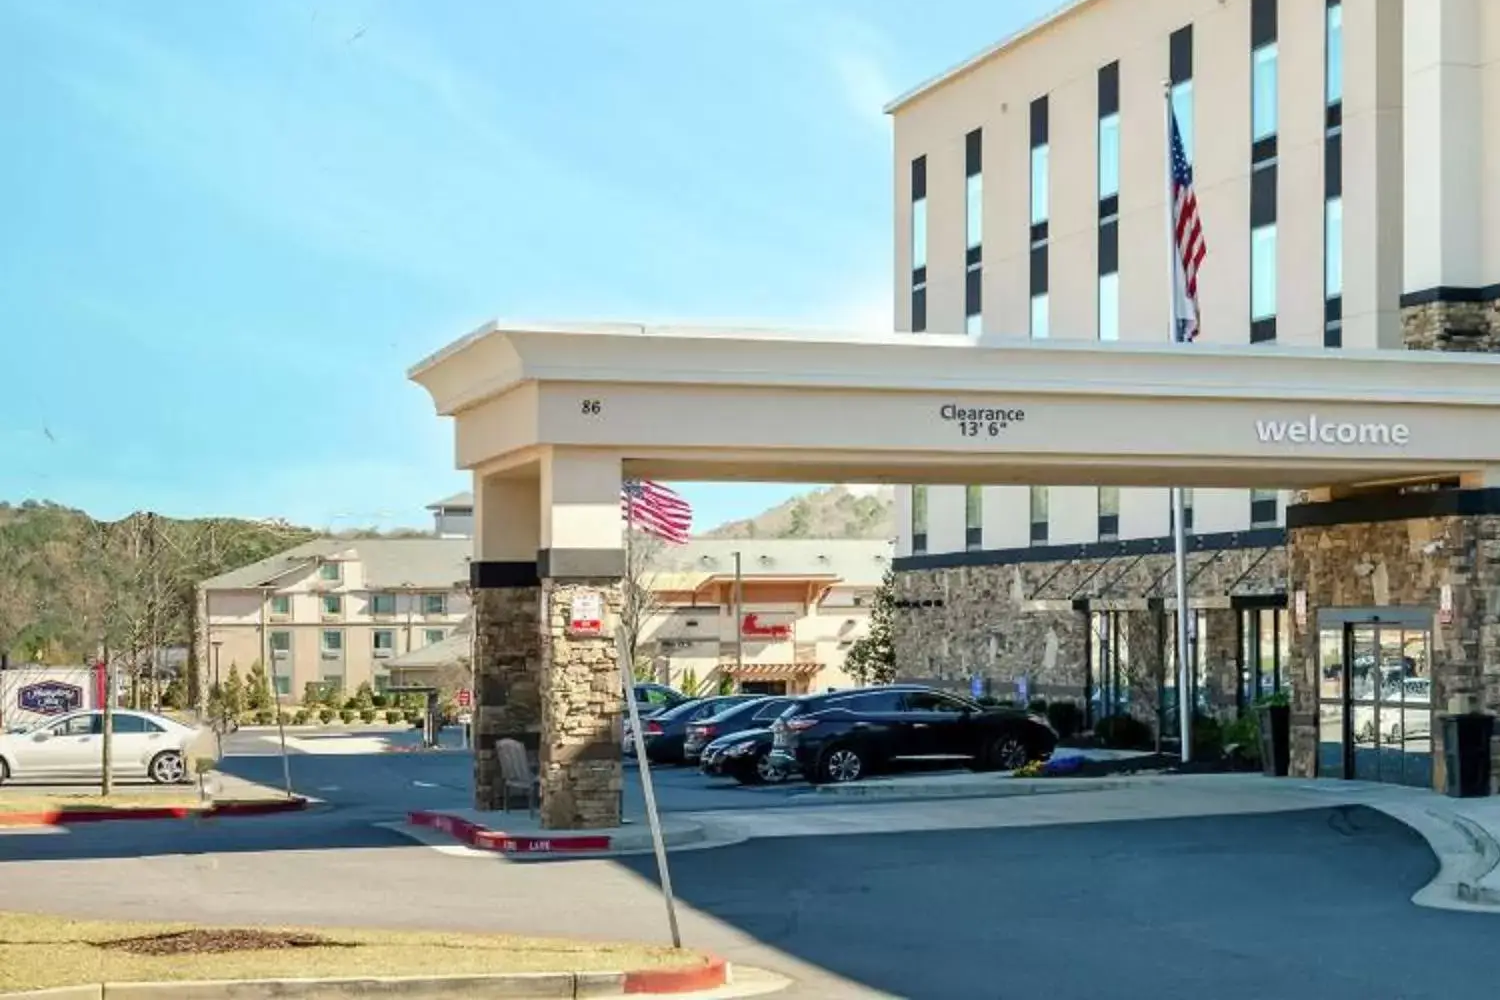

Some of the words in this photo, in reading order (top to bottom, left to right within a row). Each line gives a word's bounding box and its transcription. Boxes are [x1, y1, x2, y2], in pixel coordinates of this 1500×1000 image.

[581, 399, 601, 415] 86
[940, 404, 1025, 421] Clearance
[959, 421, 983, 437] 13'
[1255, 413, 1410, 445] welcome
